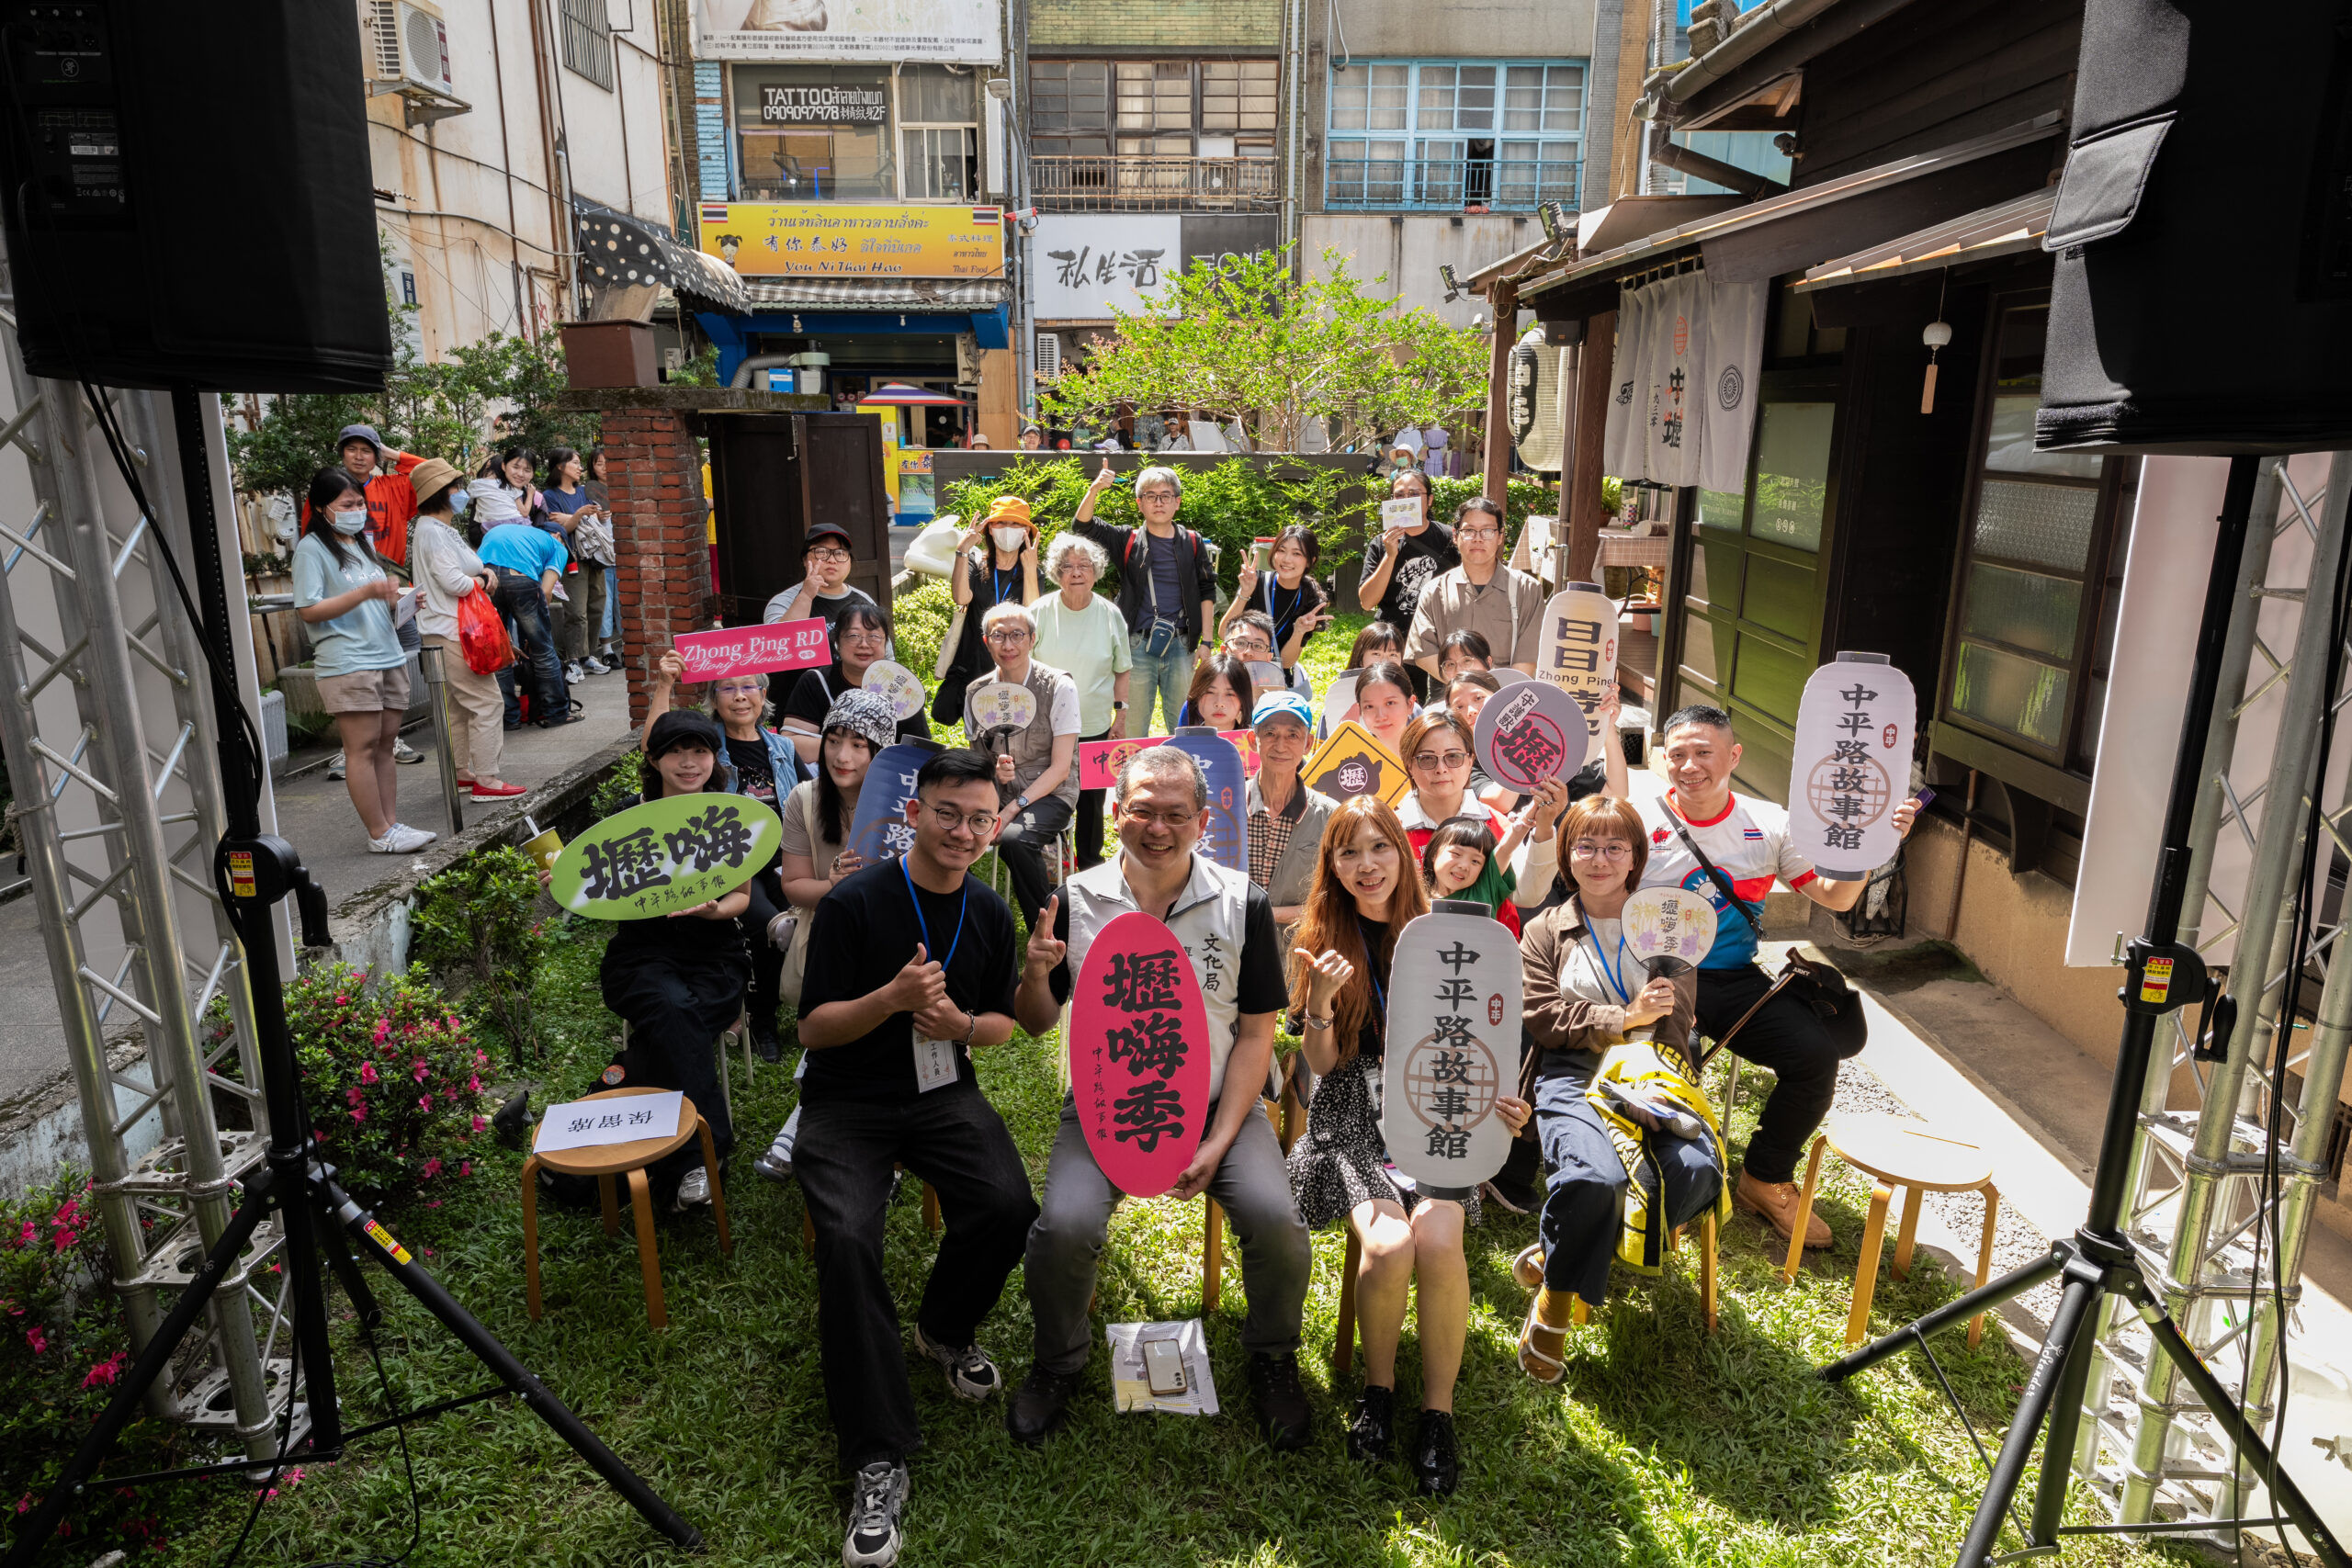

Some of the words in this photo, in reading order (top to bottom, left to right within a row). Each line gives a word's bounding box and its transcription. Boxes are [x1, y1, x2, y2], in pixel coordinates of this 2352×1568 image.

[764, 88, 831, 106] TATTOO
[763, 106, 840, 120] 0909097978
[764, 235, 848, 253] 有你泰好
[947, 234, 994, 243] 泰式料理
[785, 261, 812, 274] You
[871, 262, 902, 273] Hao
[953, 265, 967, 273] Thai
[970, 265, 989, 273] Food
[1046, 245, 1165, 288] 私生活
[684, 644, 743, 662] Zhong
[750, 636, 791, 655] Ping
[795, 629, 824, 648] RD
[691, 658, 737, 676] Story
[740, 650, 795, 667] House
[1538, 670, 1579, 685] Zhong
[1587, 675, 1613, 688] Ping
[1498, 693, 1535, 732] 守護獸
[1883, 727, 1895, 746] 中平
[1340, 767, 1365, 787] 壢
[1824, 683, 1879, 851] 中平路故事館
[579, 805, 752, 900] 壢嗨
[634, 875, 726, 913] 中平路故事館
[1661, 899, 1679, 953] 壢嗨季
[1201, 933, 1224, 993] 文化局
[1792, 967, 1810, 976] ARMY
[1490, 998, 1502, 1022] 中平
[931, 1043, 941, 1077] 工作人員
[1102, 949, 1189, 1154] 壢嗨季
[1425, 941, 1481, 1160] 中平路故事館
[1091, 1046, 1108, 1140] 中平路故事館
[568, 1110, 653, 1133] 保留席
